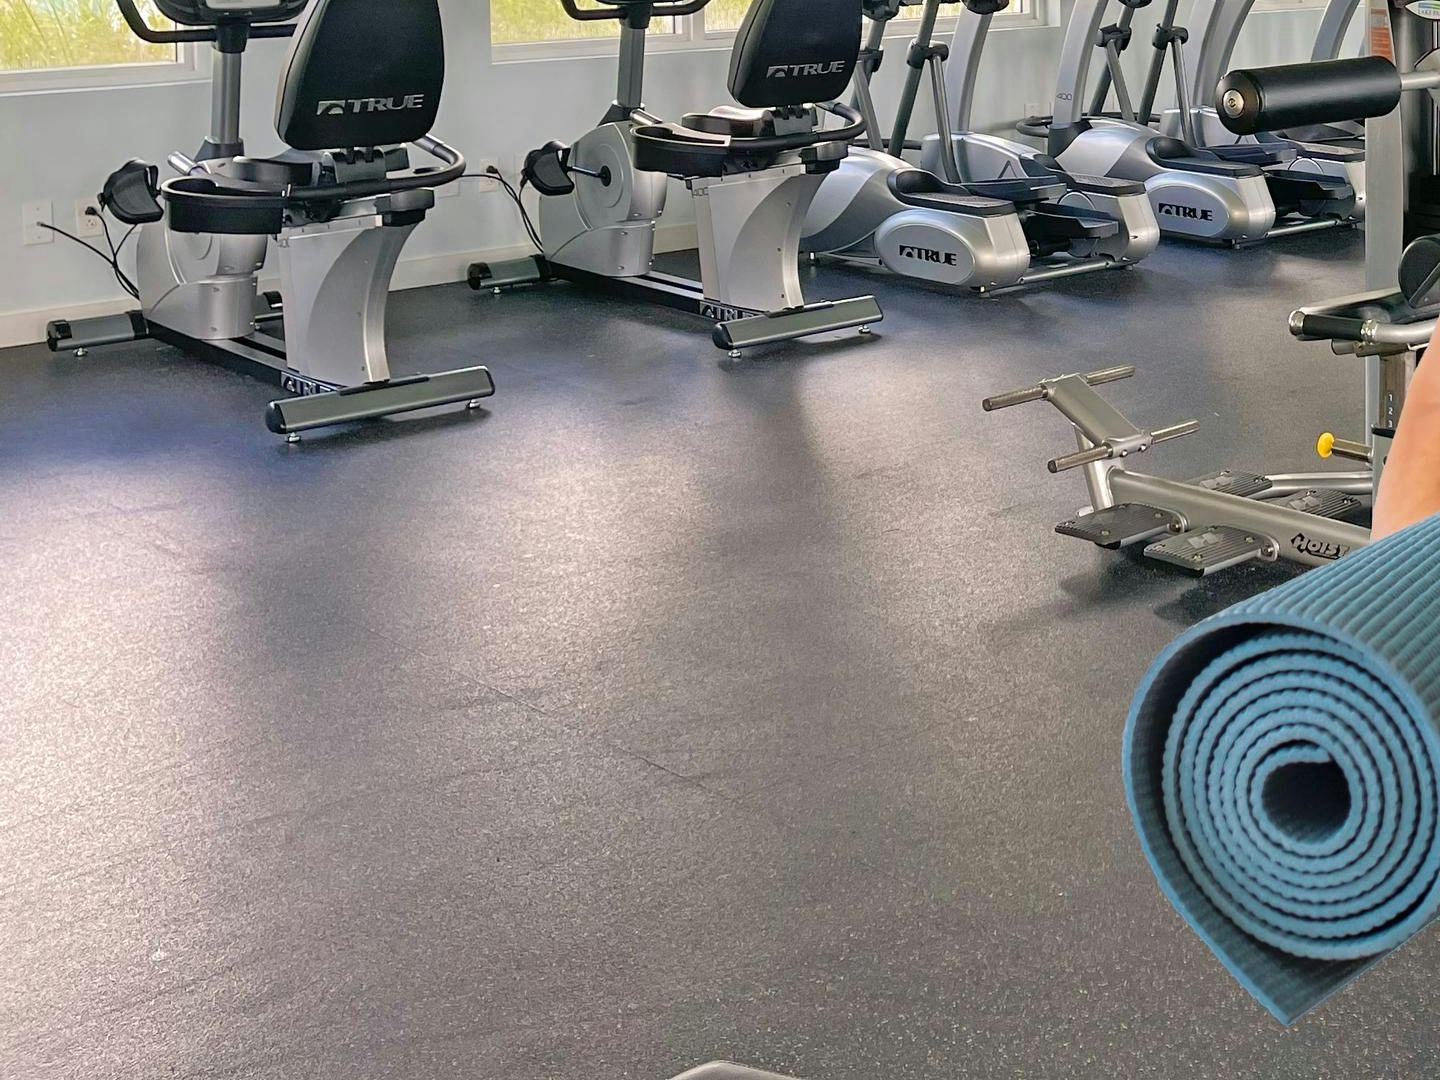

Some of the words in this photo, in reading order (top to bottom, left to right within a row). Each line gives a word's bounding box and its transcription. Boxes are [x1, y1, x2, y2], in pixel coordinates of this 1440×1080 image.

[789, 60, 845, 76] TRUE
[348, 94, 424, 113] TRUE
[1172, 204, 1213, 221] TRUE
[913, 246, 957, 266] TRUE
[1291, 534, 1350, 557] HOIST
